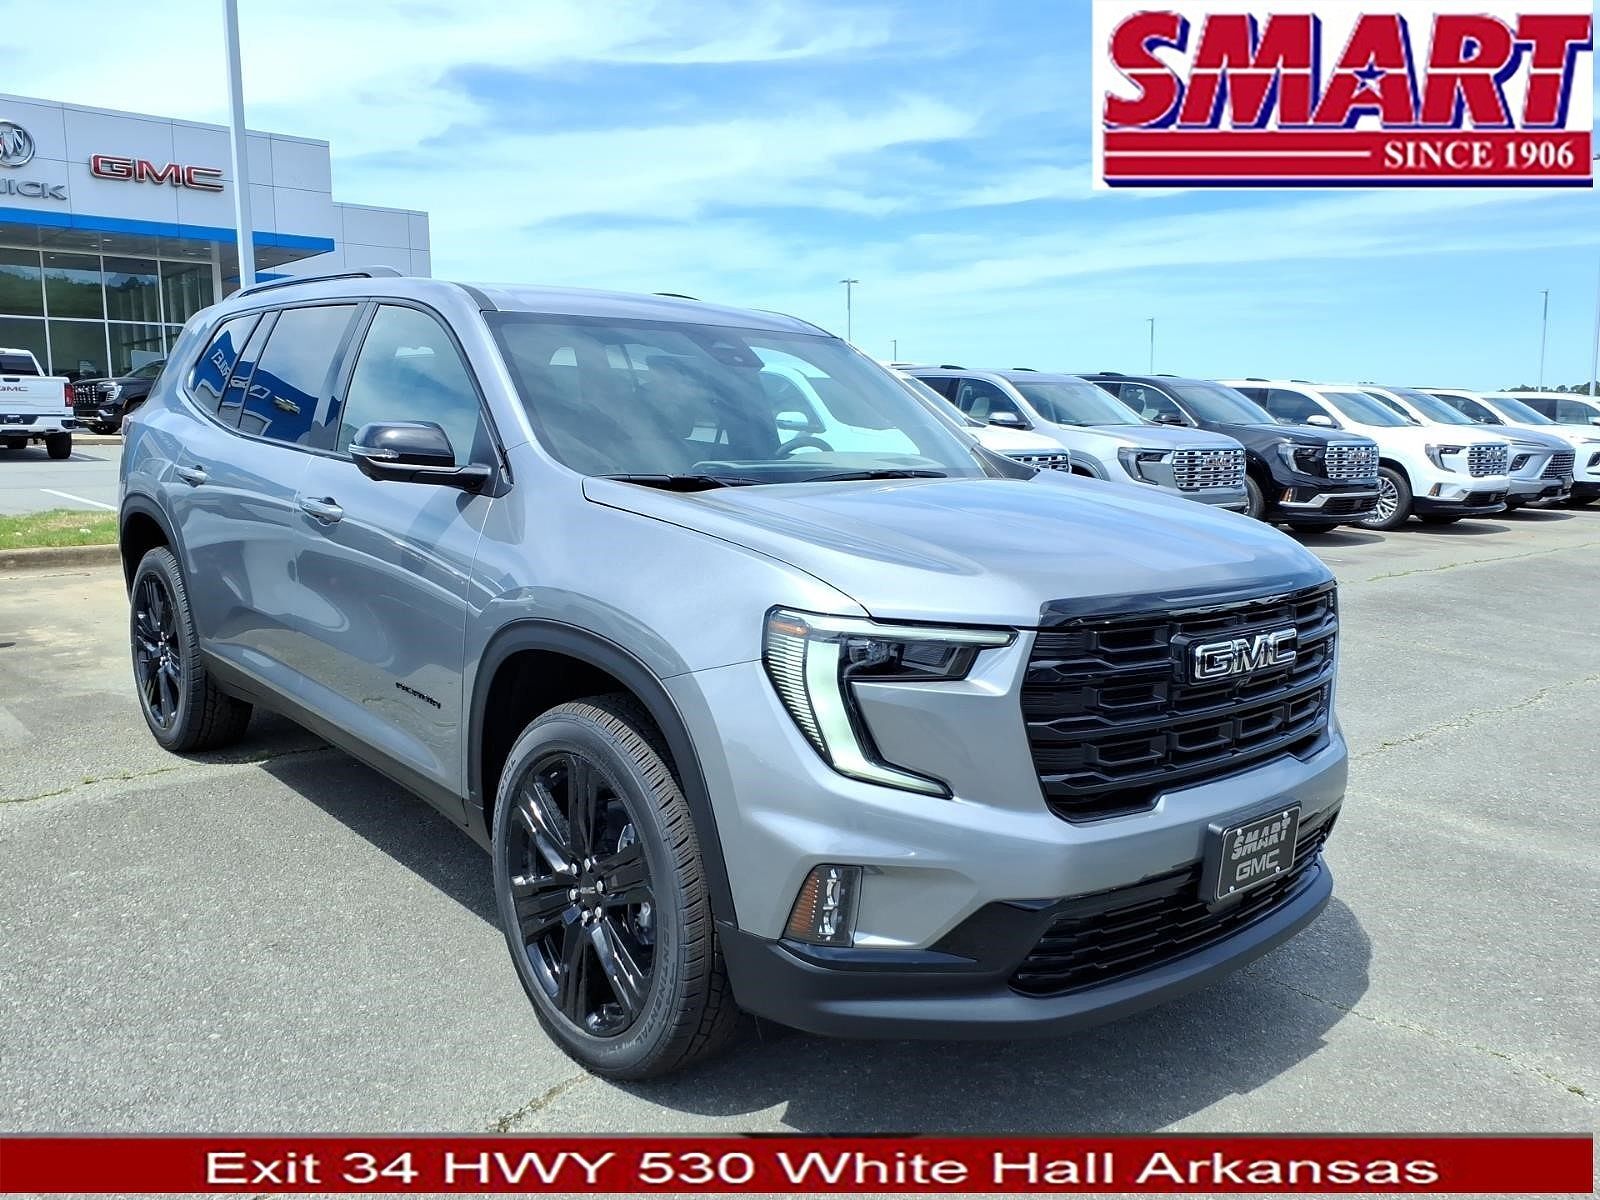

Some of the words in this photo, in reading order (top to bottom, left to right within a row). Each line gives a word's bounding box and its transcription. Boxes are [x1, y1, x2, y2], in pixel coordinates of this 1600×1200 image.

[90, 153, 224, 192] GMC
[1194, 628, 1297, 680] GMC
[1231, 817, 1291, 860] SMART
[1236, 848, 1280, 881] GMC
